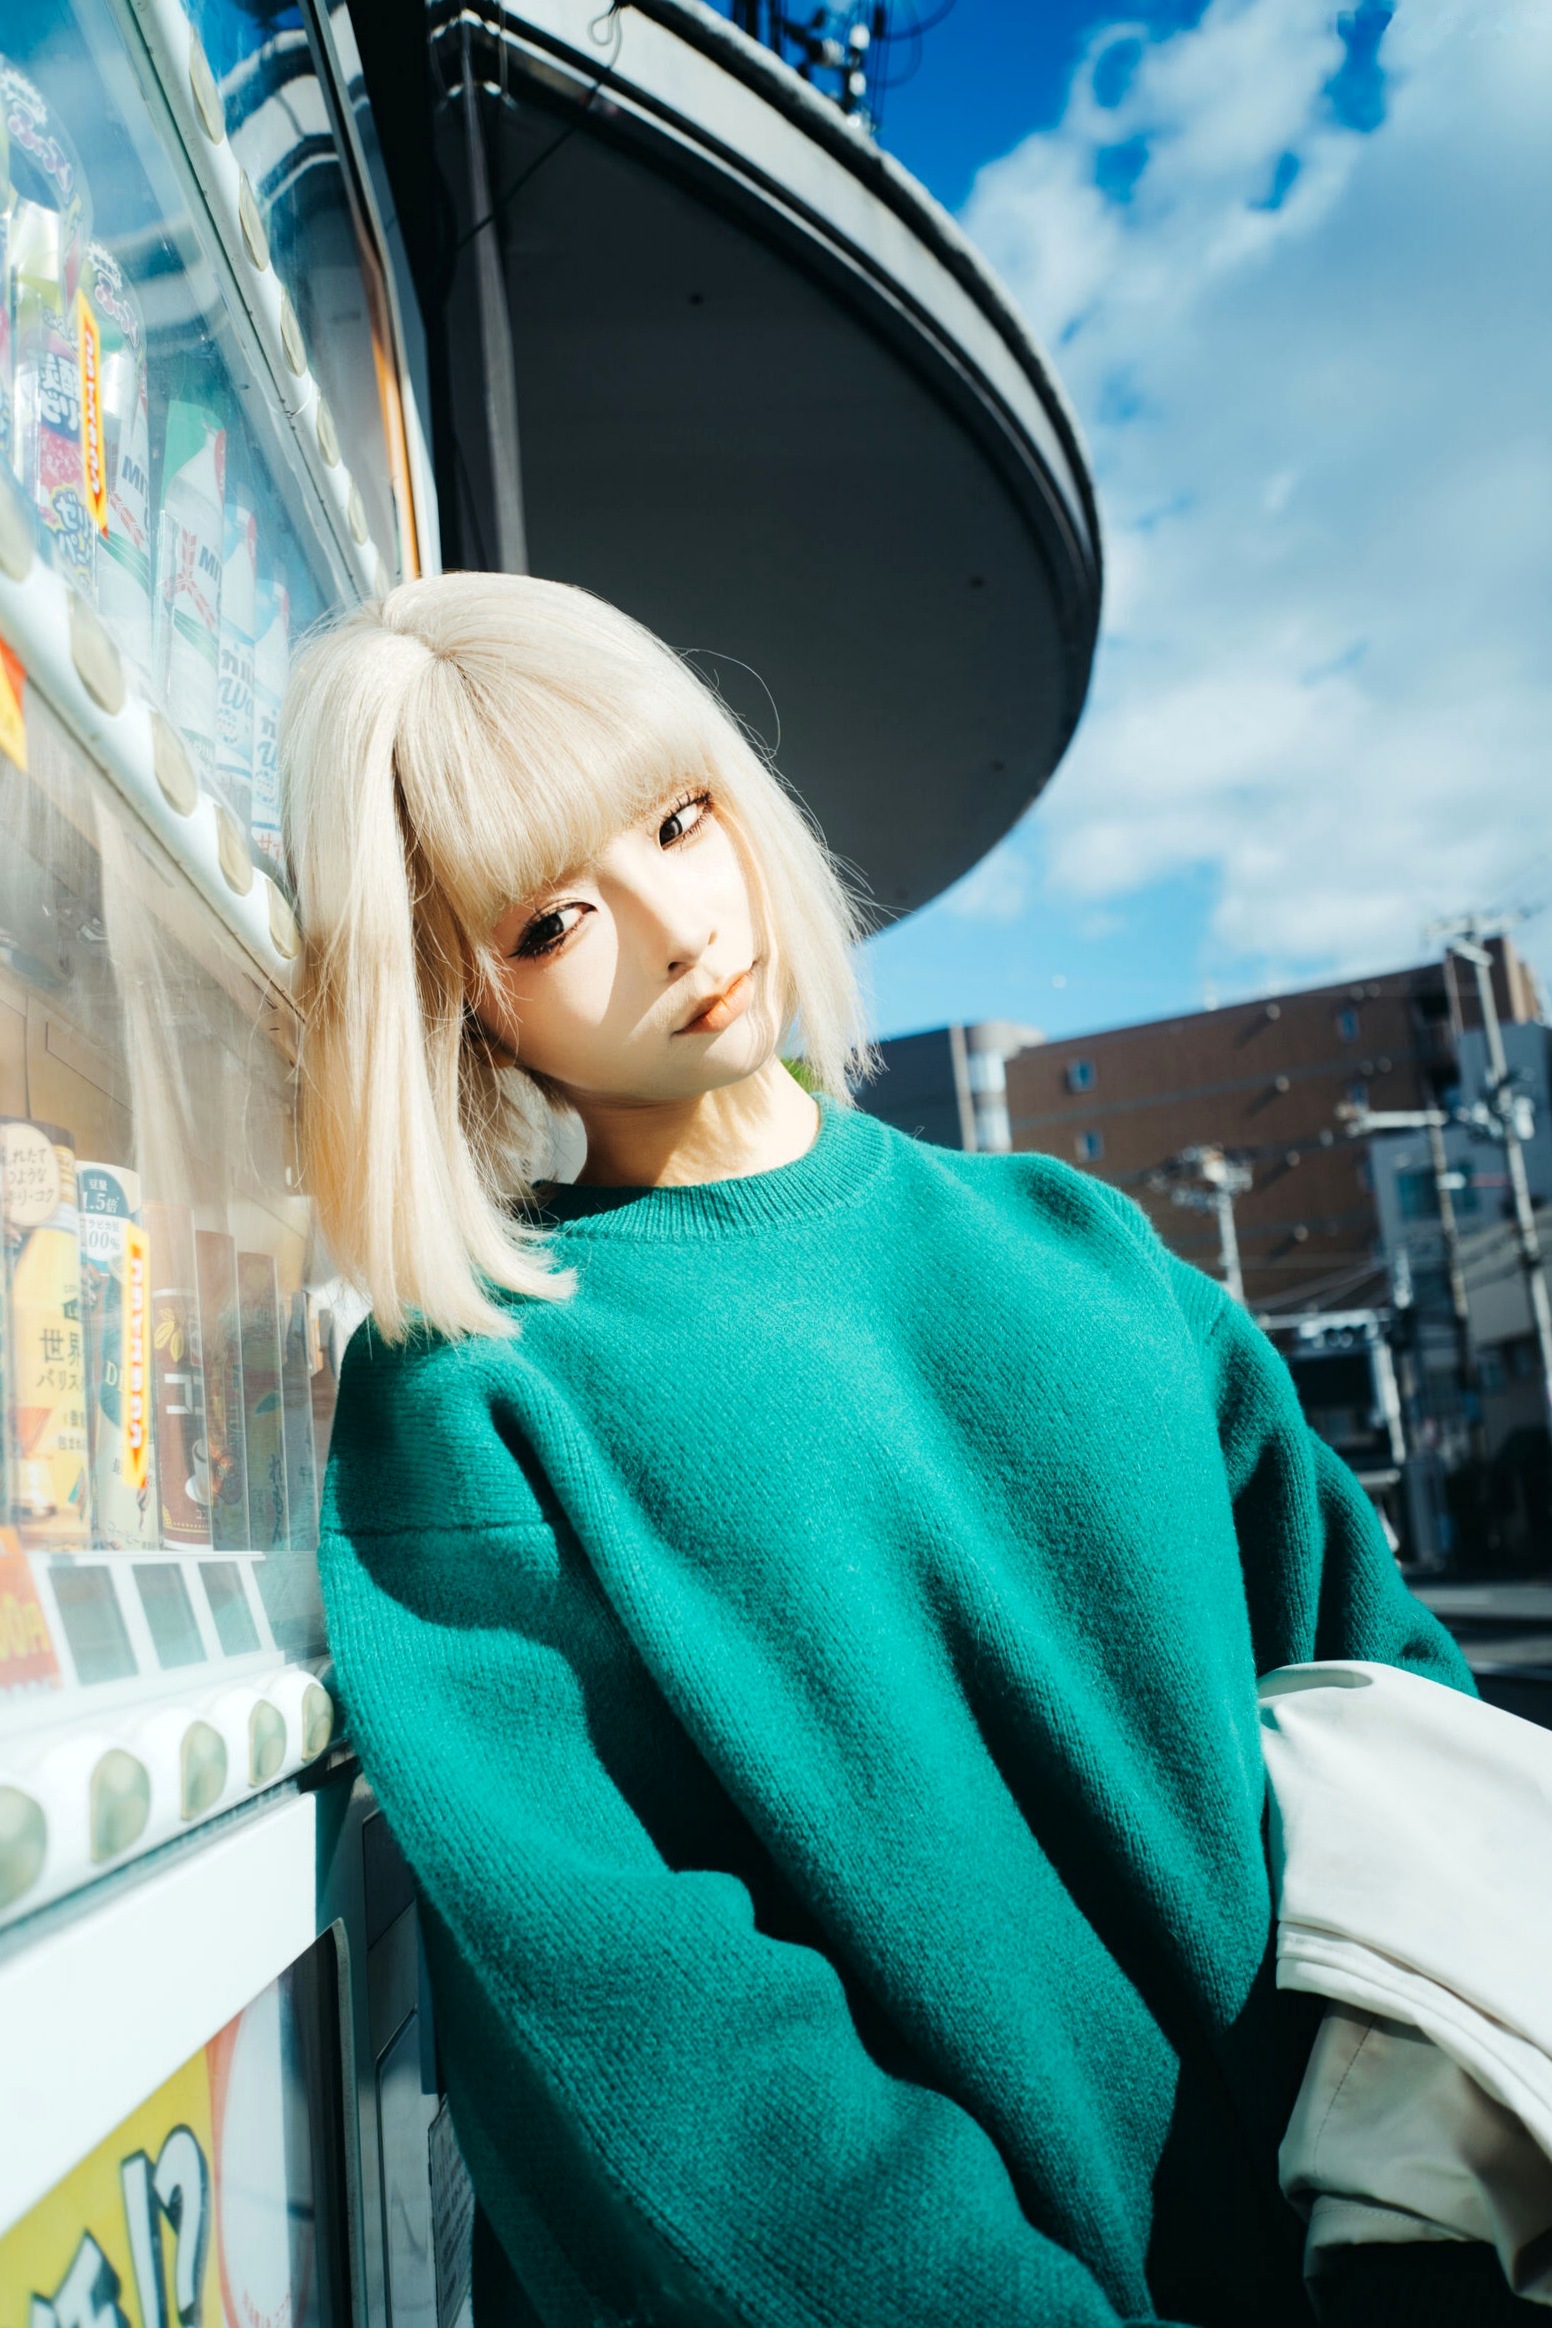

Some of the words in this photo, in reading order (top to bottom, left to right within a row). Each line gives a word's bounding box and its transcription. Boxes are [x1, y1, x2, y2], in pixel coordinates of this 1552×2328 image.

[88, 1231, 120, 1250] 00%
[36, 1367, 84, 1393] バリス
